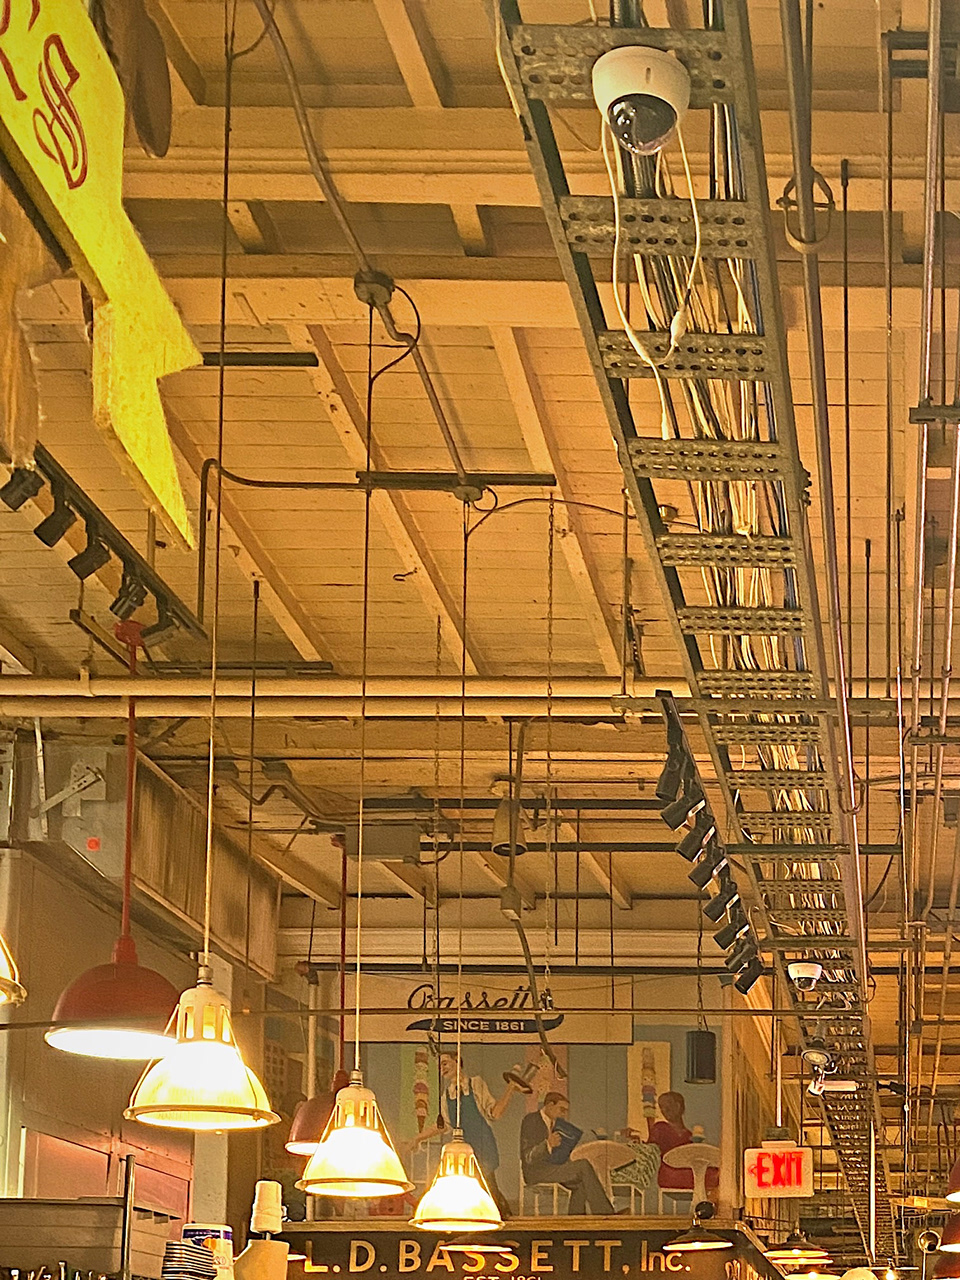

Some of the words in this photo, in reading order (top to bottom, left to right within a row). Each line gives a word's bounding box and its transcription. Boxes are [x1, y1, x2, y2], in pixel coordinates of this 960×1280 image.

[442, 1021, 490, 1031] SINCE
[495, 1021, 525, 1031] 1861
[756, 1151, 804, 1188] EXIT
[641, 1239, 692, 1273] Inc.
